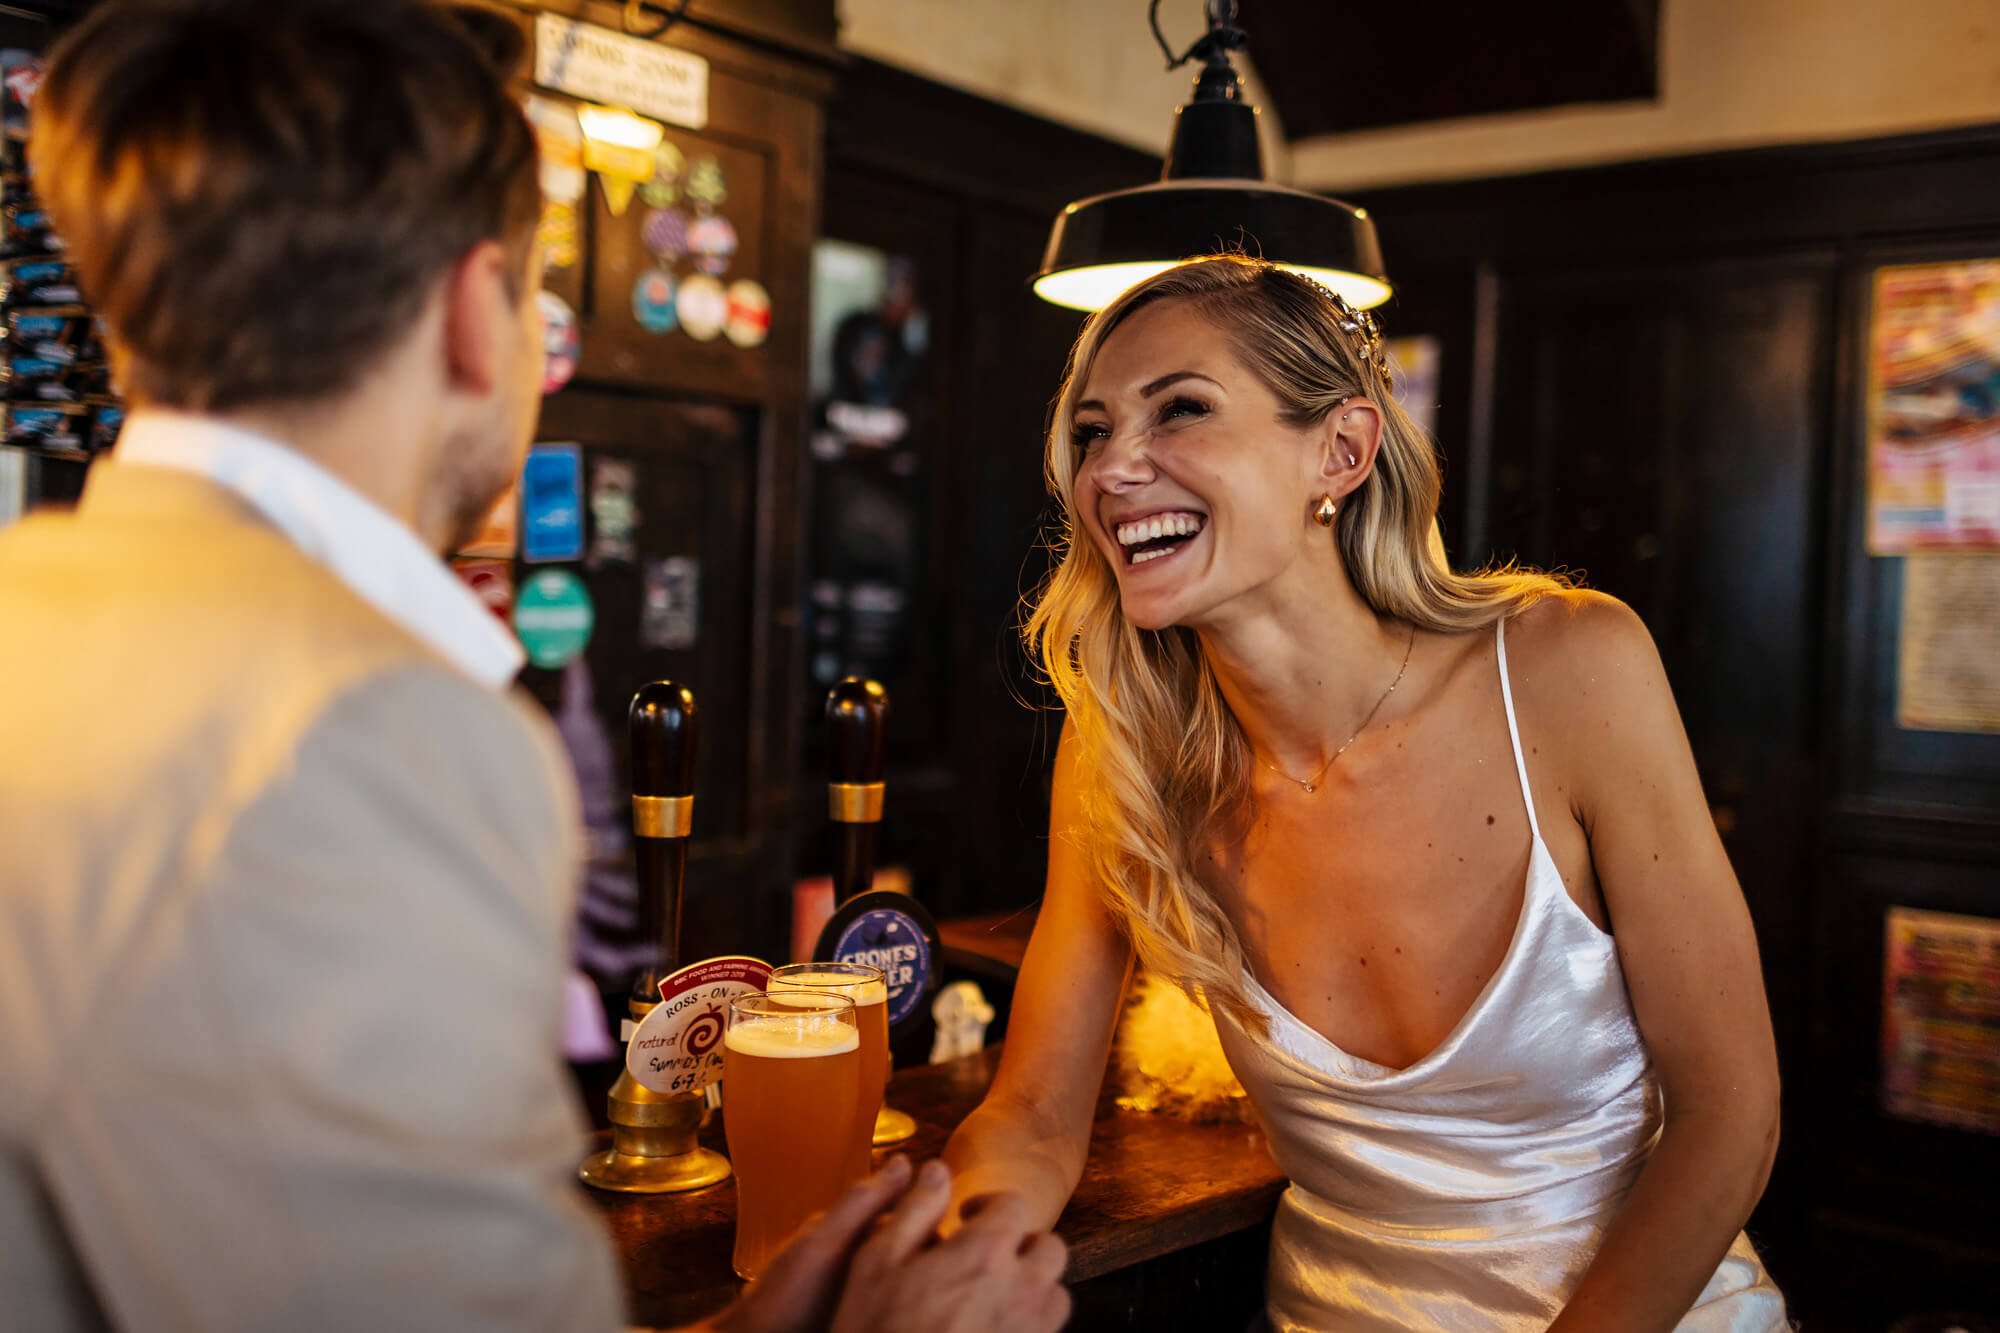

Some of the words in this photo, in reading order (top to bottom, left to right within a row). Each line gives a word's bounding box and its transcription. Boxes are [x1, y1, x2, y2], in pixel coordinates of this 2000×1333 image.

[688, 967, 708, 978] FOOD
[708, 964, 722, 972] AND
[666, 993, 698, 1019] ROSS
[710, 987, 729, 999] ON
